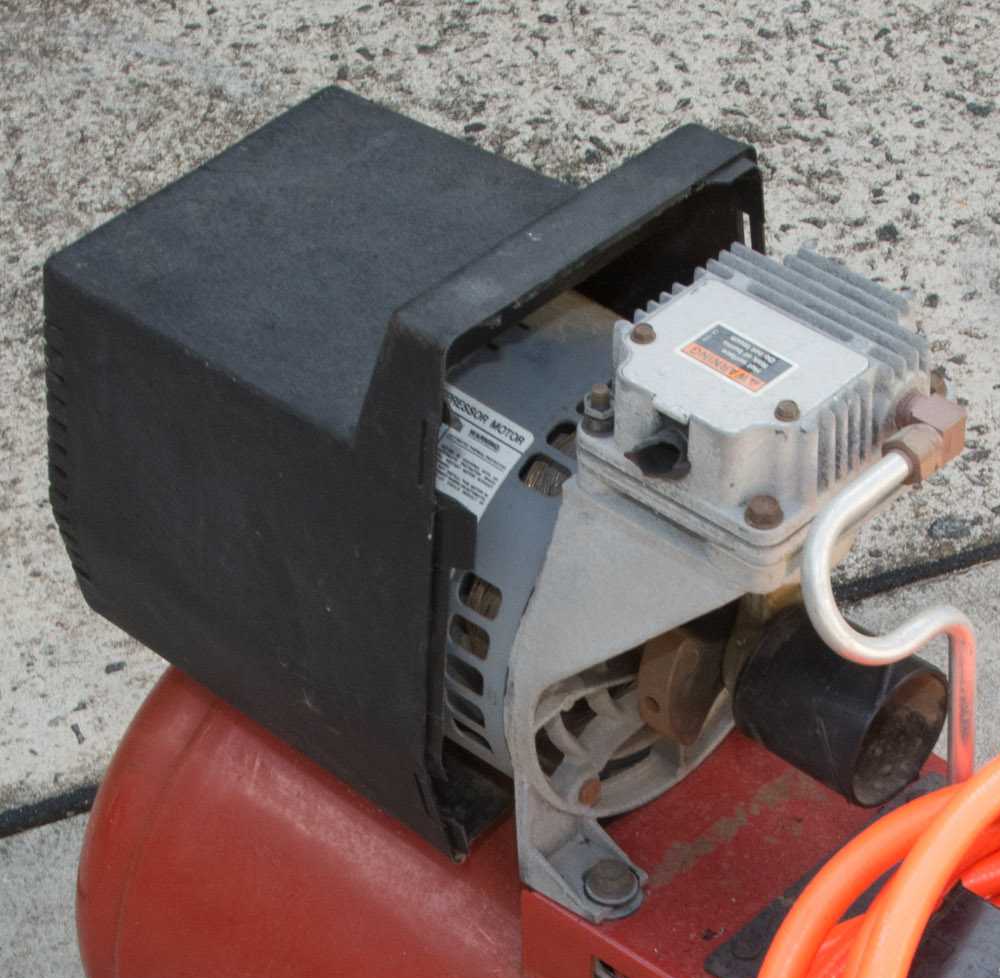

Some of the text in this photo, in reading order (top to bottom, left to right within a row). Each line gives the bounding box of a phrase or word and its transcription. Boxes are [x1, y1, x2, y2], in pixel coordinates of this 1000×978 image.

[721, 348, 761, 373] Hot surface
[730, 335, 776, 364] Do not touch
[690, 346, 746, 380] WARNING
[752, 356, 769, 369] Risk
[490, 420, 525, 445] MOTOR
